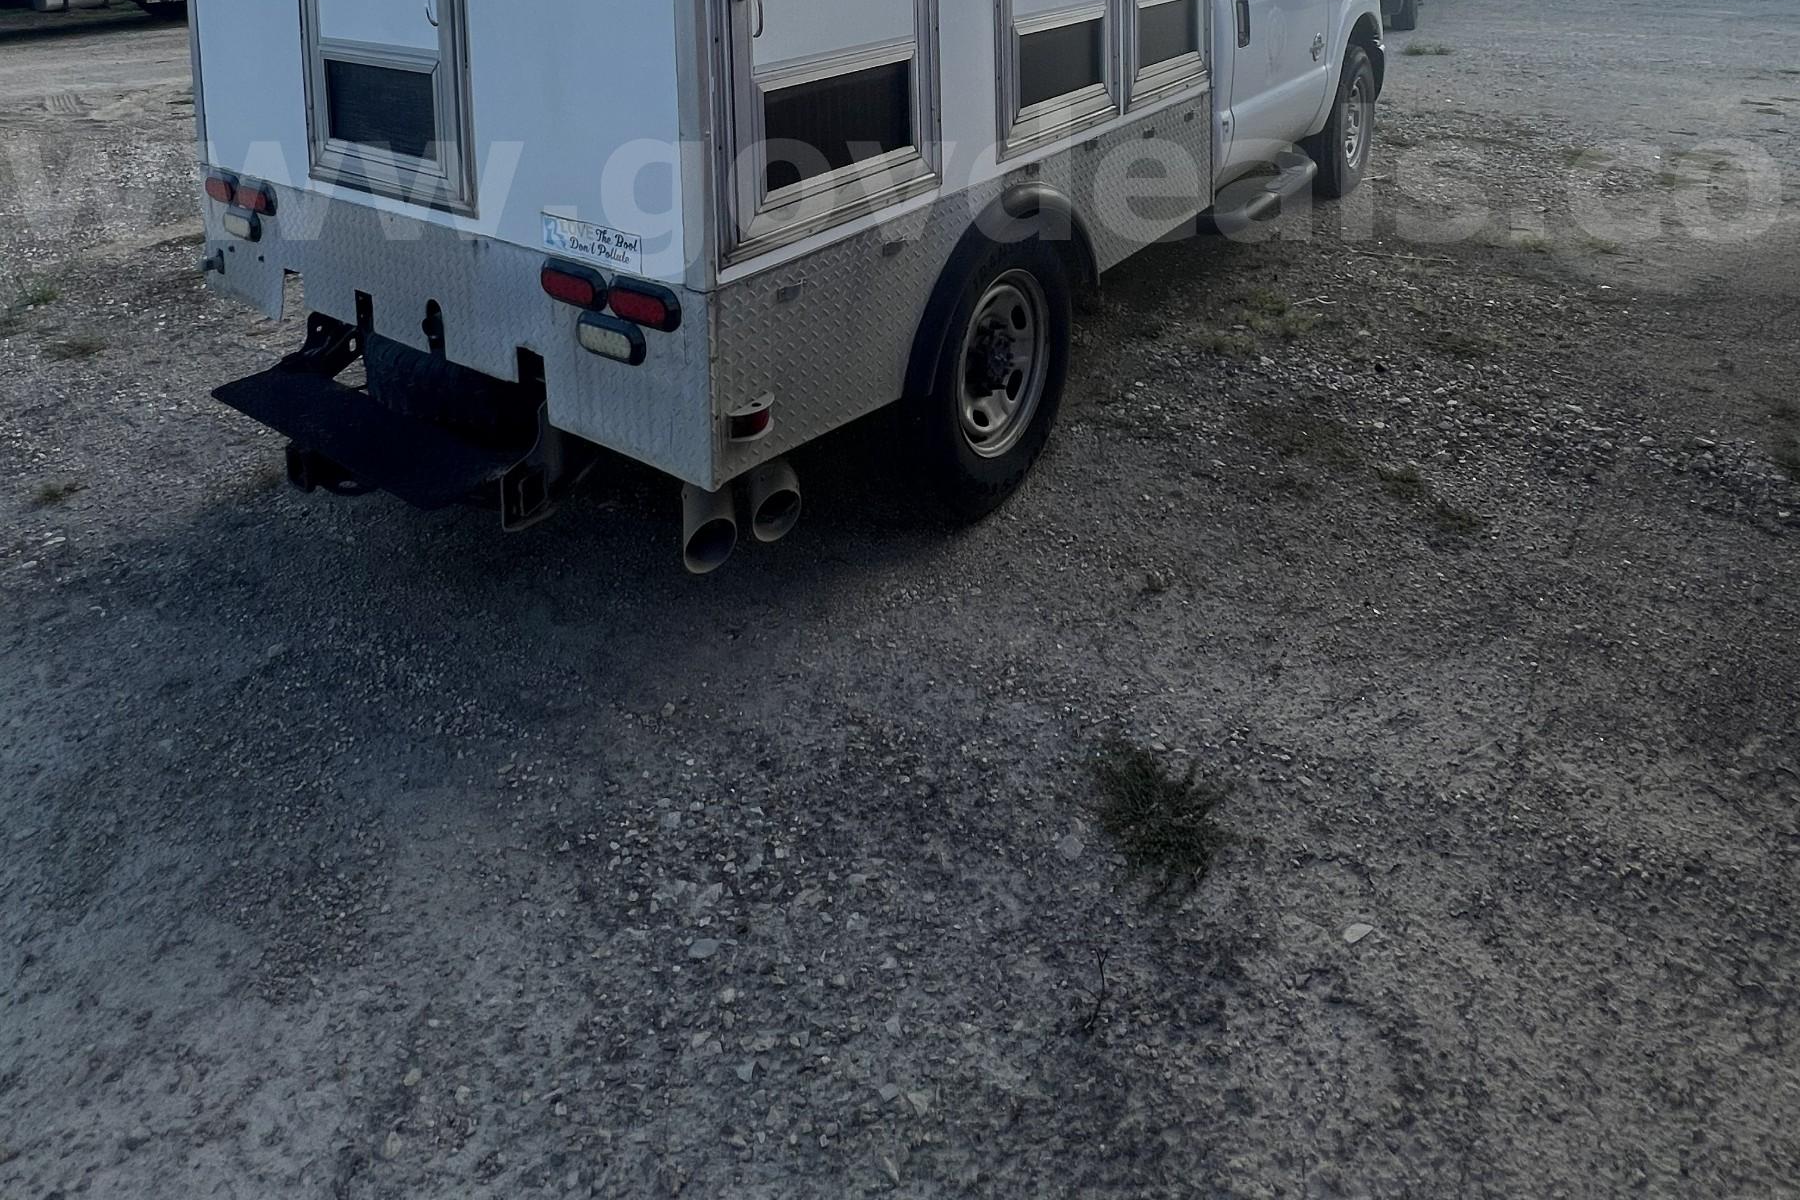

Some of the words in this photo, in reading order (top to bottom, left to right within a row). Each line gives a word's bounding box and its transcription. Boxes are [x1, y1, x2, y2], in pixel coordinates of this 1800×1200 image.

[595, 228, 613, 244] The
[569, 235, 595, 254] Don't
[597, 243, 630, 264] Pollute
